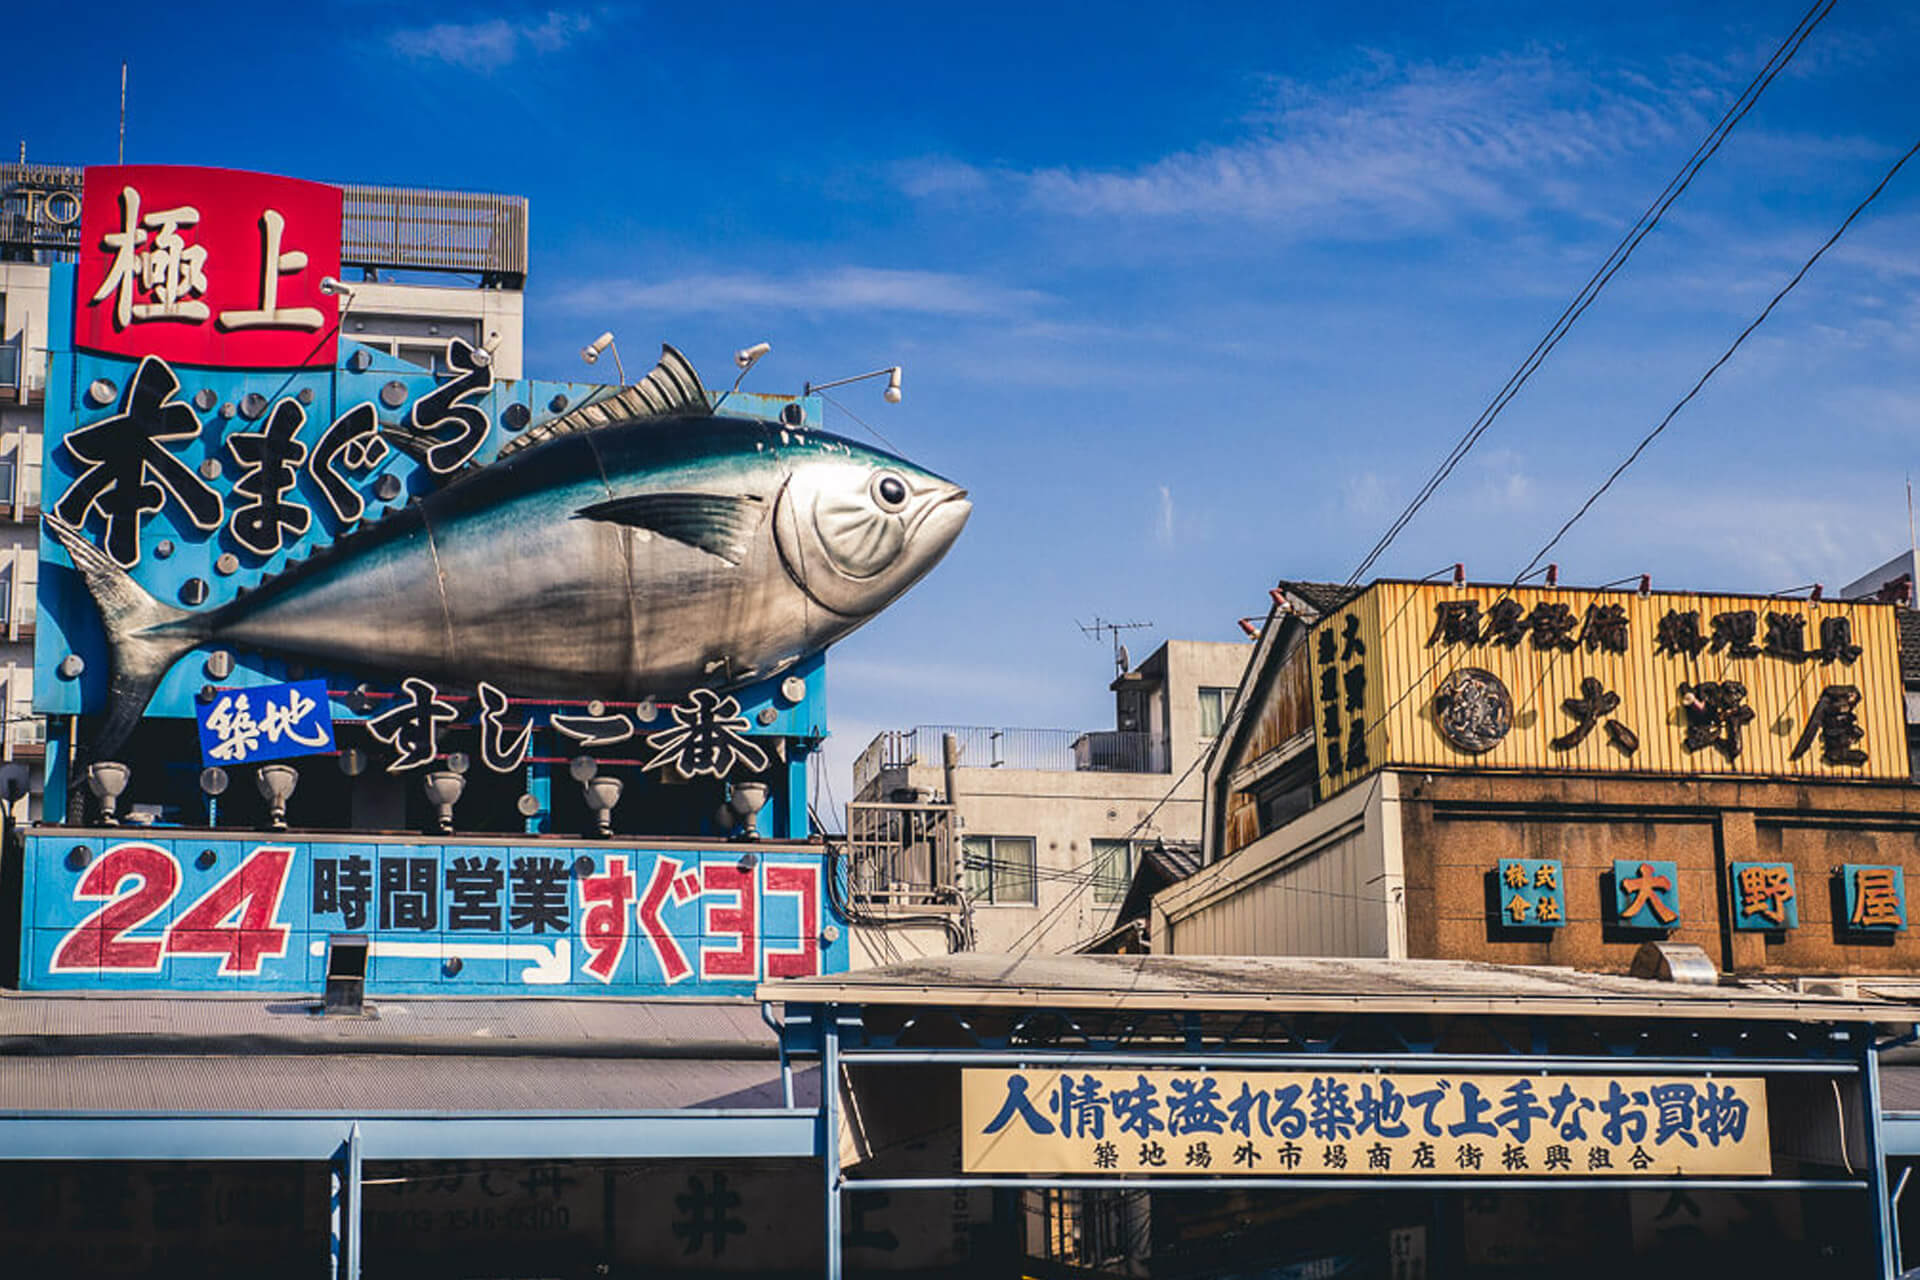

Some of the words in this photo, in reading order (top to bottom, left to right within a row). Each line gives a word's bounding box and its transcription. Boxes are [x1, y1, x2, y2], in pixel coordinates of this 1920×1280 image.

[93, 185, 325, 330] 極上
[53, 336, 495, 569] 本まぐろ
[204, 689, 332, 760] 築地
[366, 677, 771, 780] すし一番
[1550, 676, 1870, 766] 大野屋
[50, 843, 297, 976] 24
[982, 1074, 1750, 1148] 人情味溢れる築地で上手なお買物
[1093, 1141, 1656, 1171] 築地場外市場商店街振興組合
